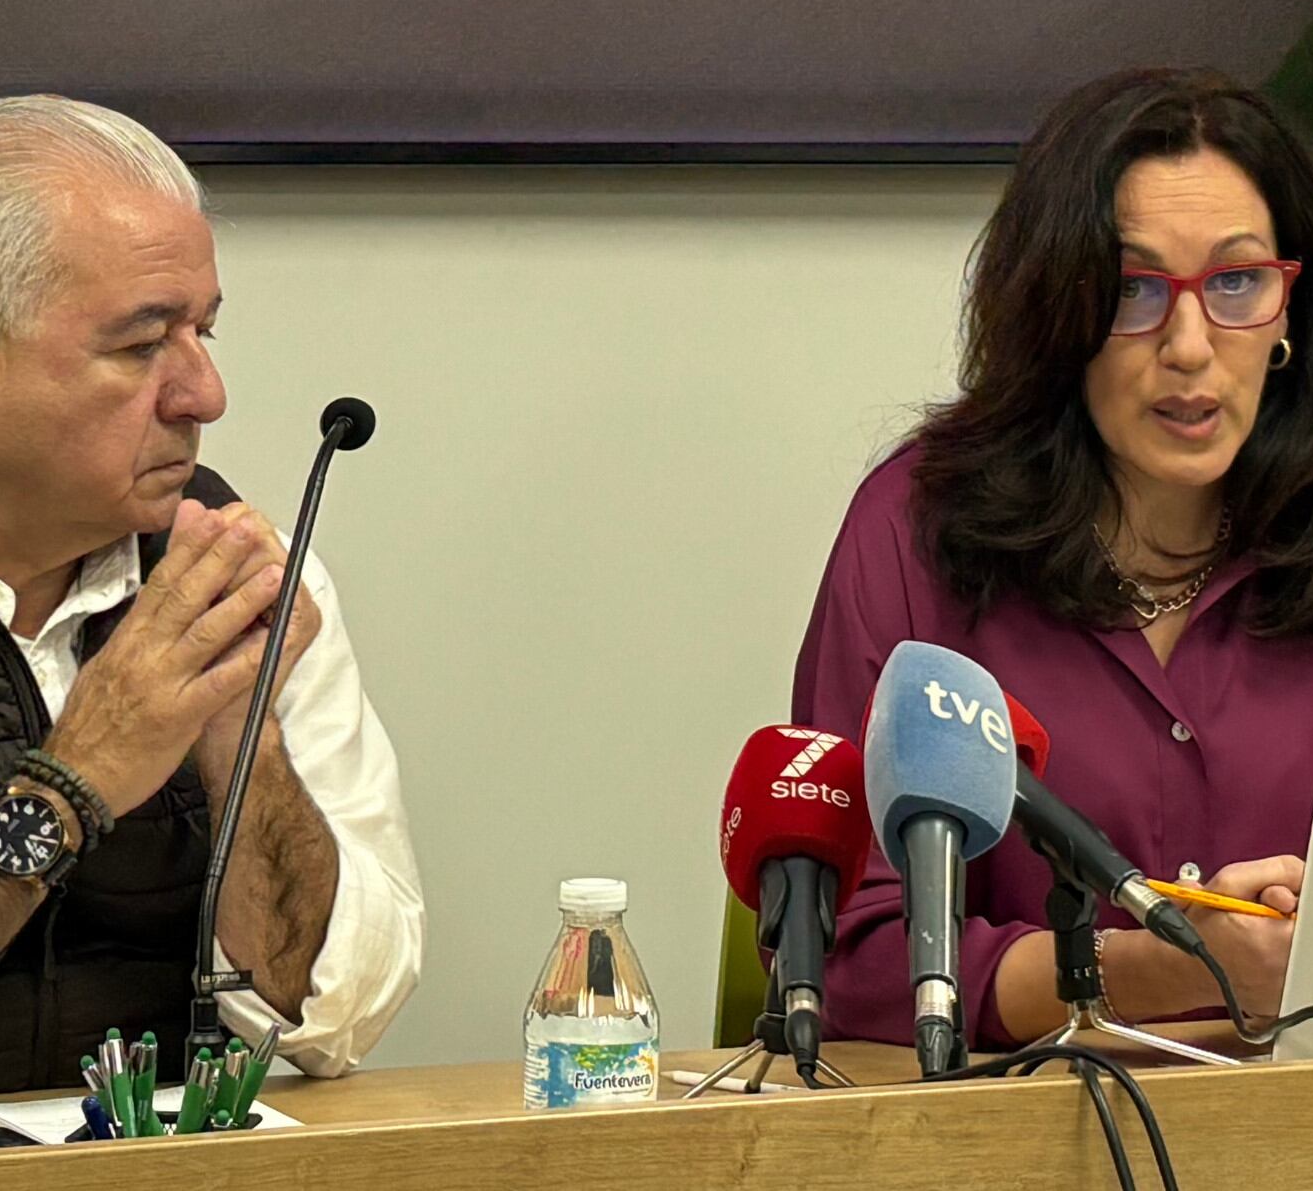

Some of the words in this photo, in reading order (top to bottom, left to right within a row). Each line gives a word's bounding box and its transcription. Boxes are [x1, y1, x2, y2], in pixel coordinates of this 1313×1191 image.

[924, 680, 1008, 754] tve
[776, 728, 844, 778] 7
[771, 780, 851, 807] siete
[575, 1072, 652, 1089] Fuentevera
